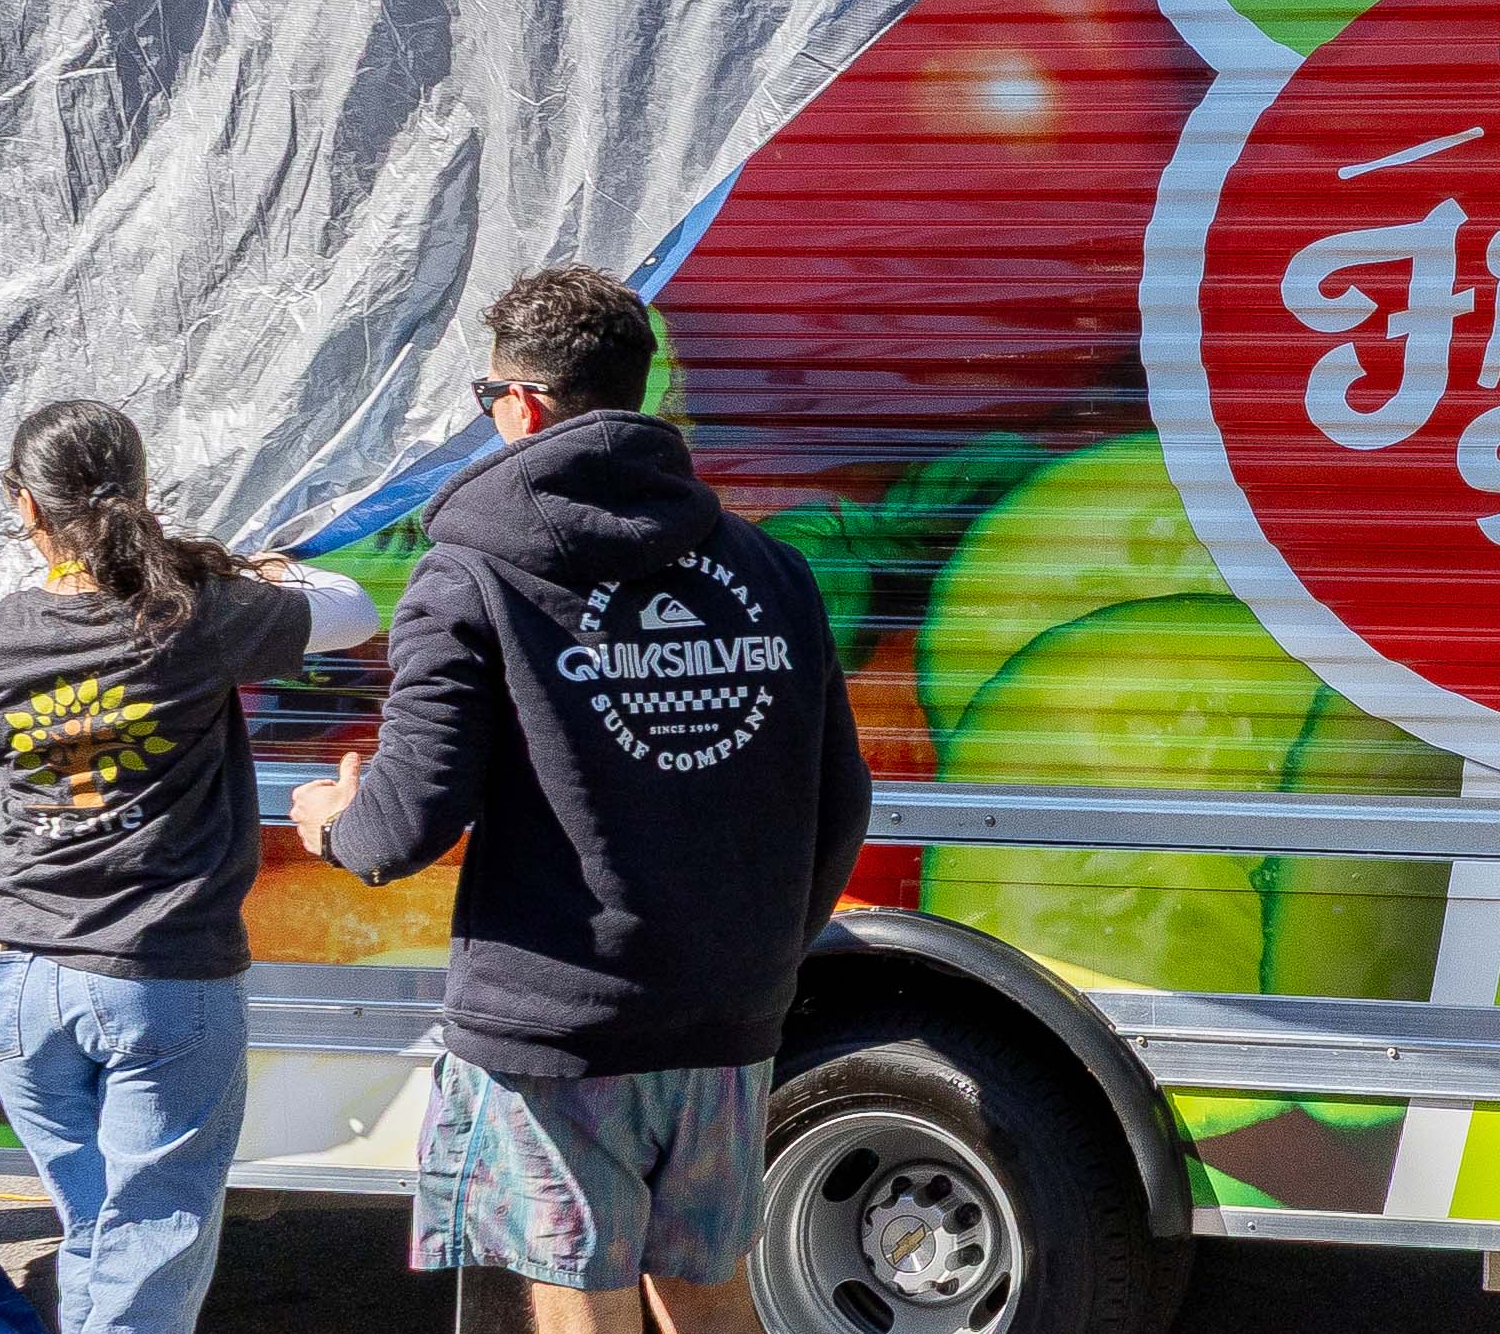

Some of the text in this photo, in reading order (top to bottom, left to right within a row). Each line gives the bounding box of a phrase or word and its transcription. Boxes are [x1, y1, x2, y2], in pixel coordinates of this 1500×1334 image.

[665, 551, 764, 623] GINAL
[557, 636, 793, 682] QUIKSILVER
[591, 685, 773, 771] SURF COMPANY
[649, 723, 719, 735] SINCE 1969
